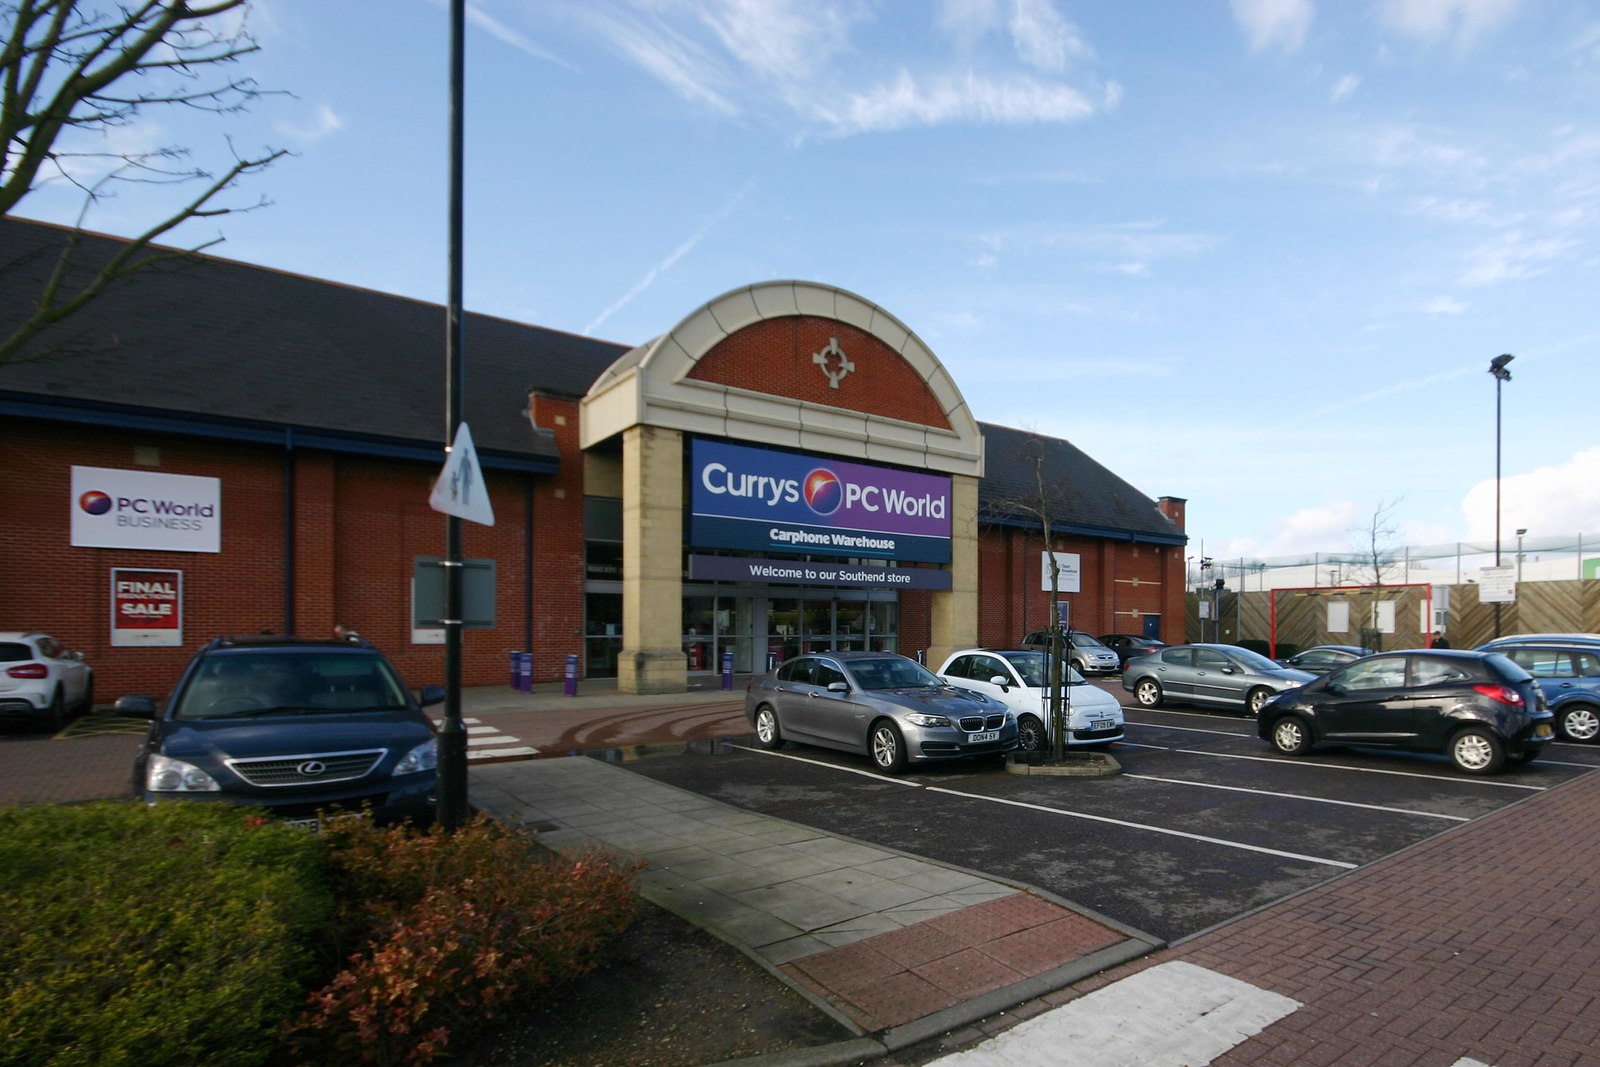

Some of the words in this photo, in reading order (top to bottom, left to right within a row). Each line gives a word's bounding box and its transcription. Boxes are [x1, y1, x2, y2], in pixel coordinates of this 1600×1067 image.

[702, 462, 800, 506] Currys
[846, 483, 880, 512] PC
[882, 488, 946, 519] World
[117, 497, 148, 513] PC
[151, 500, 215, 518] World
[117, 514, 203, 531] BUSINESS
[769, 528, 831, 544] Carphone
[831, 534, 896, 550] Warehouse
[749, 564, 803, 578] Welcome
[805, 569, 817, 579] to
[819, 571, 837, 580] our
[839, 570, 886, 583] Southend
[887, 573, 911, 583] store
[117, 581, 176, 594] FINAL
[121, 603, 172, 615] SALE
